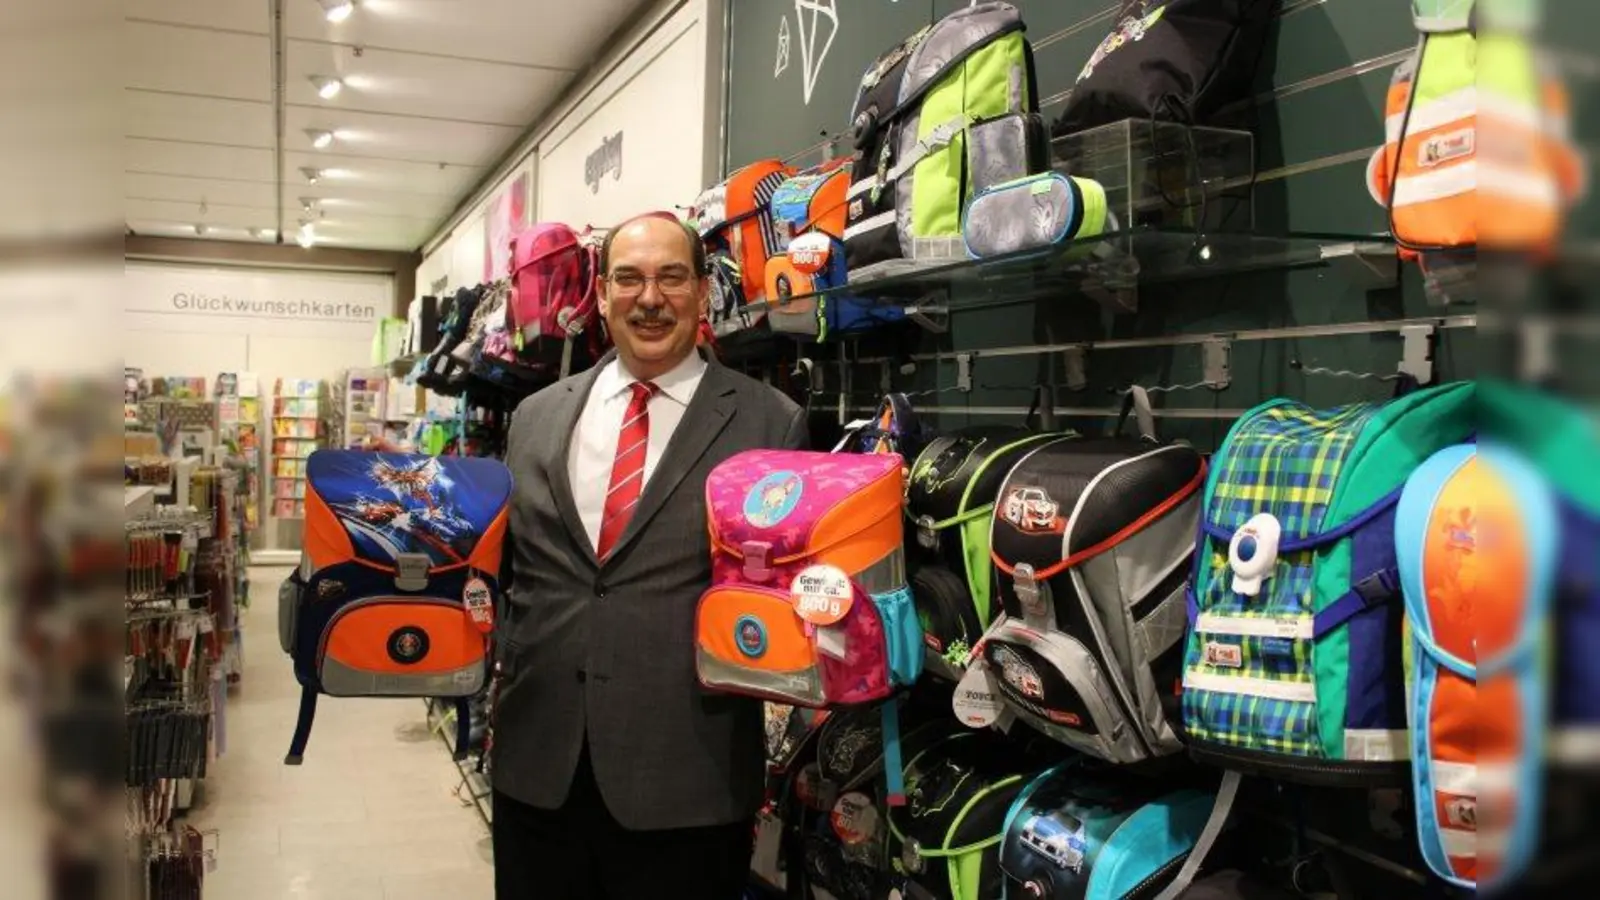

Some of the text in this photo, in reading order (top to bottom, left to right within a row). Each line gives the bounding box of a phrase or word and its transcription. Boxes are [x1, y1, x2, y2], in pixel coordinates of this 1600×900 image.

[173, 293, 375, 318] Glückwunschkarten
[800, 575, 845, 589] Gewit:
[824, 587, 840, 596] ca.
[830, 601, 840, 616] g
